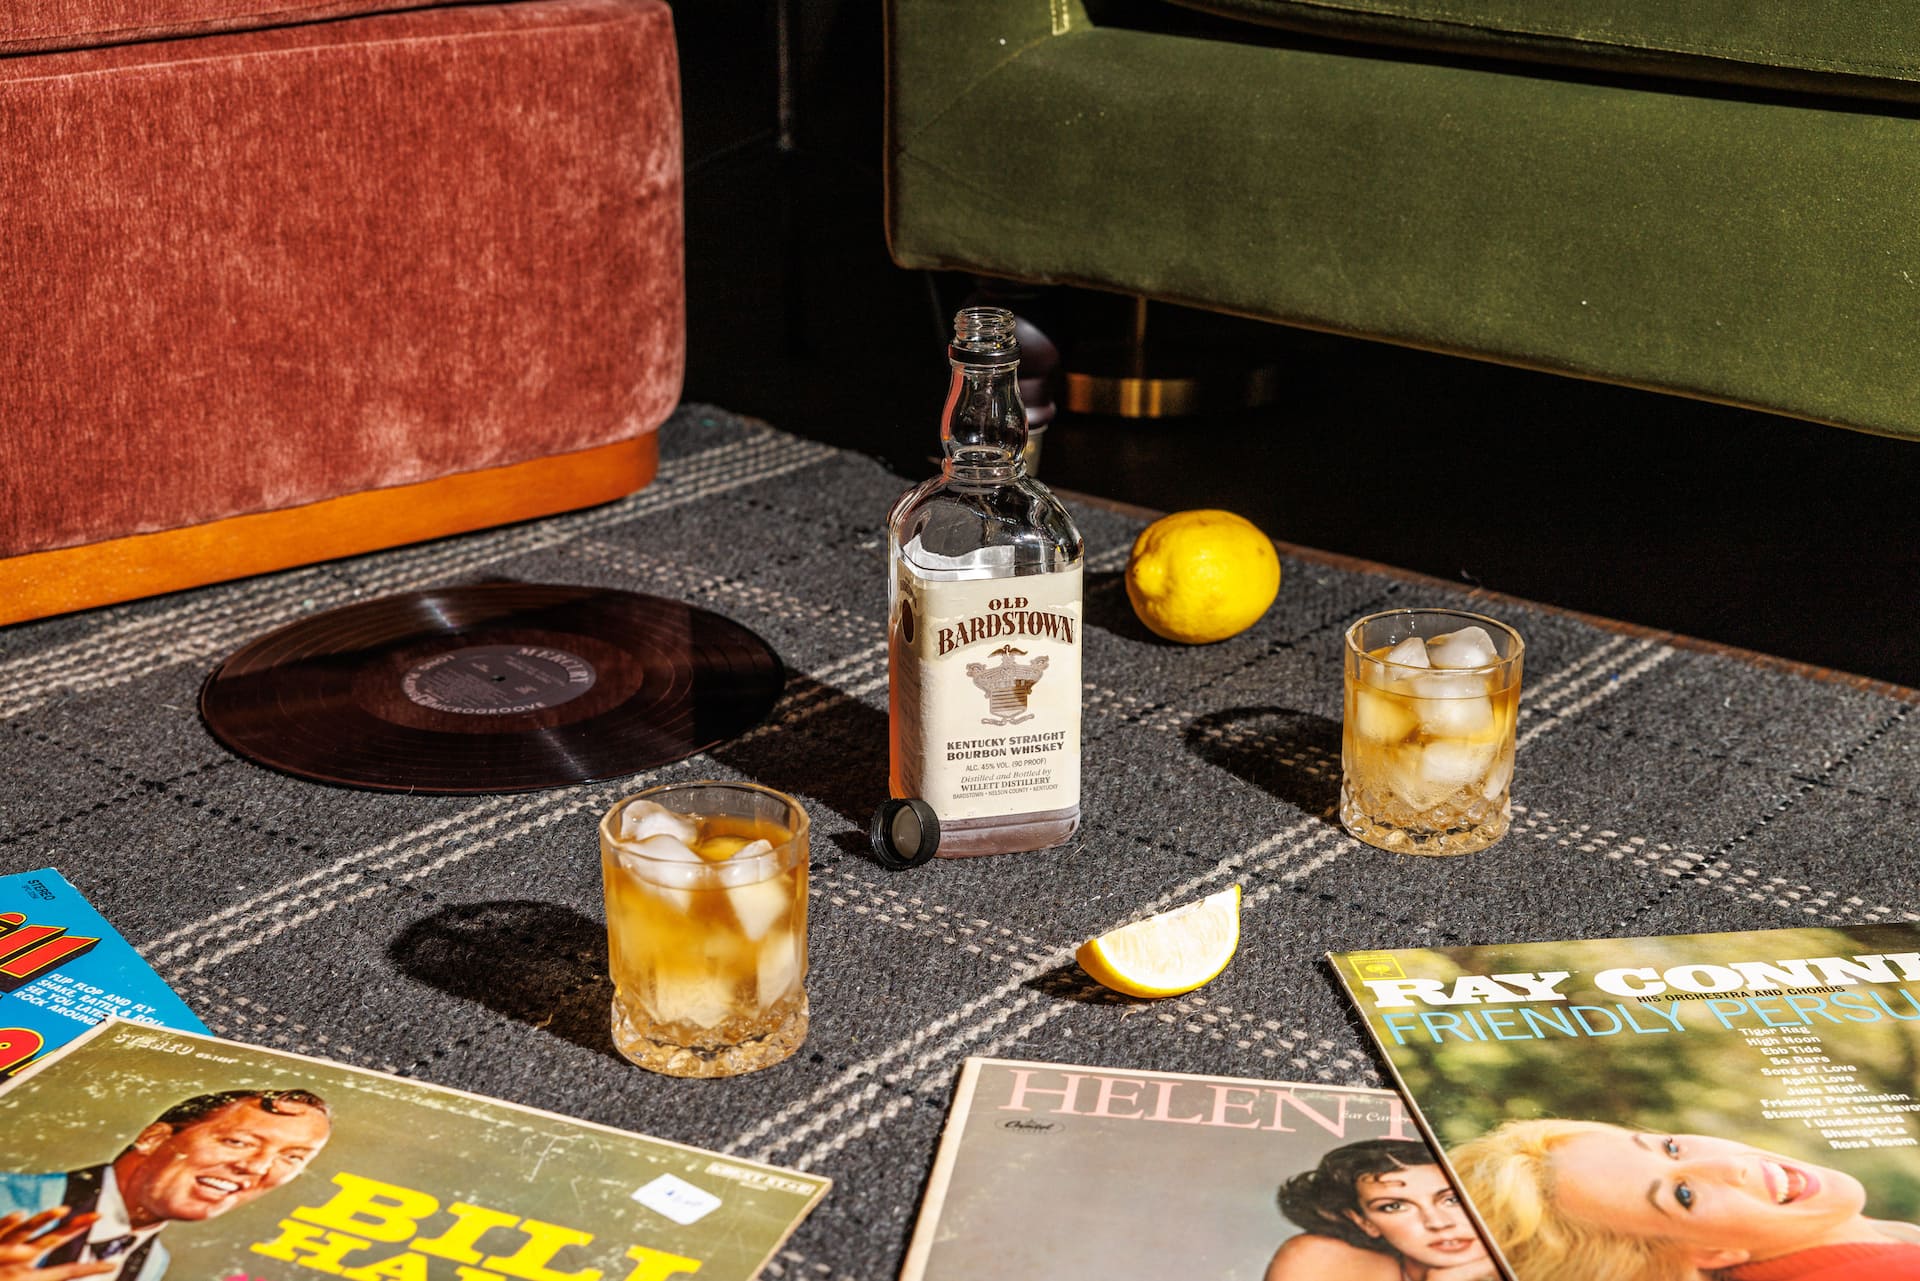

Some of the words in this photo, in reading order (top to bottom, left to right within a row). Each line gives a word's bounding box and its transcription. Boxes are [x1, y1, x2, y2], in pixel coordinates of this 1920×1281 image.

[988, 597, 1028, 610] OLD
[938, 611, 1075, 656] BARDSTOWN
[428, 701, 547, 715] MICROGROOVE
[947, 738, 1006, 750] KENTUCKY
[1009, 731, 1066, 745] STRAIGHT
[947, 748, 1007, 760] BOURBON
[1010, 742, 1064, 755] WHISKEY
[981, 762, 995, 770] 45%
[997, 761, 1010, 769] VOL.
[1012, 760, 1022, 768] (90
[1024, 758, 1047, 766] PROOF)
[961, 775, 994, 784] Distilled
[1013, 770, 1041, 779] Bottled
[1042, 769, 1052, 777] by
[961, 782, 1000, 792] WILLETT
[1001, 777, 1050, 788] DISTILLERY
[953, 792, 984, 800] BARDSTOWN
[28, 879, 56, 901] STEREO
[37, 979, 77, 998] SHAKE,
[79, 994, 115, 1011] RATTL
[48, 973, 74, 984] FLIP
[73, 982, 104, 996] FLOP
[103, 994, 132, 1007] AND
[1363, 971, 1571, 1008] RAY
[1636, 995, 1661, 1003] HIS
[1665, 991, 1750, 1001] ORCHESTRA
[1755, 989, 1783, 998] AND
[1787, 985, 1846, 996] CHORUS
[13, 991, 48, 1007] ROCK
[48, 1004, 100, 1026] AROUND
[24, 985, 48, 996] SEE
[48, 993, 75, 1007] YOU
[74, 1003, 106, 1019] LATE
[1381, 1000, 1685, 1045] FRIENDLY
[1705, 989, 1920, 1029] PERSU
[1738, 1028, 1776, 1037] Tiger
[1780, 1026, 1811, 1035] Rag
[1746, 1037, 1780, 1047] High
[1783, 1035, 1821, 1044] Noon
[1760, 1047, 1789, 1056] Ebb
[1789, 1045, 1822, 1055] Tide
[1769, 1056, 1790, 1066] So
[1793, 1055, 1831, 1064] Rare
[1761, 1067, 1802, 1077] Song
[1804, 1065, 1818, 1074] of
[1823, 1064, 1857, 1073] Love
[1782, 1075, 1816, 1086] April
[1820, 1074, 1855, 1083] Love
[1787, 1086, 1823, 1096] June
[1825, 1083, 1868, 1094] Night
[998, 1069, 1356, 1139] HELEN
[1760, 1097, 1822, 1108] Friendly
[1825, 1092, 1910, 1105] Persuasion
[1833, 1106, 1850, 1116] at
[1853, 1104, 1880, 1115] the
[1881, 1103, 1920, 1113] Savo
[1815, 1114, 1905, 1127] Understand
[1820, 1126, 1907, 1139] Shangri-La
[1829, 1139, 1869, 1150] Rose
[1871, 1137, 1918, 1147] Room
